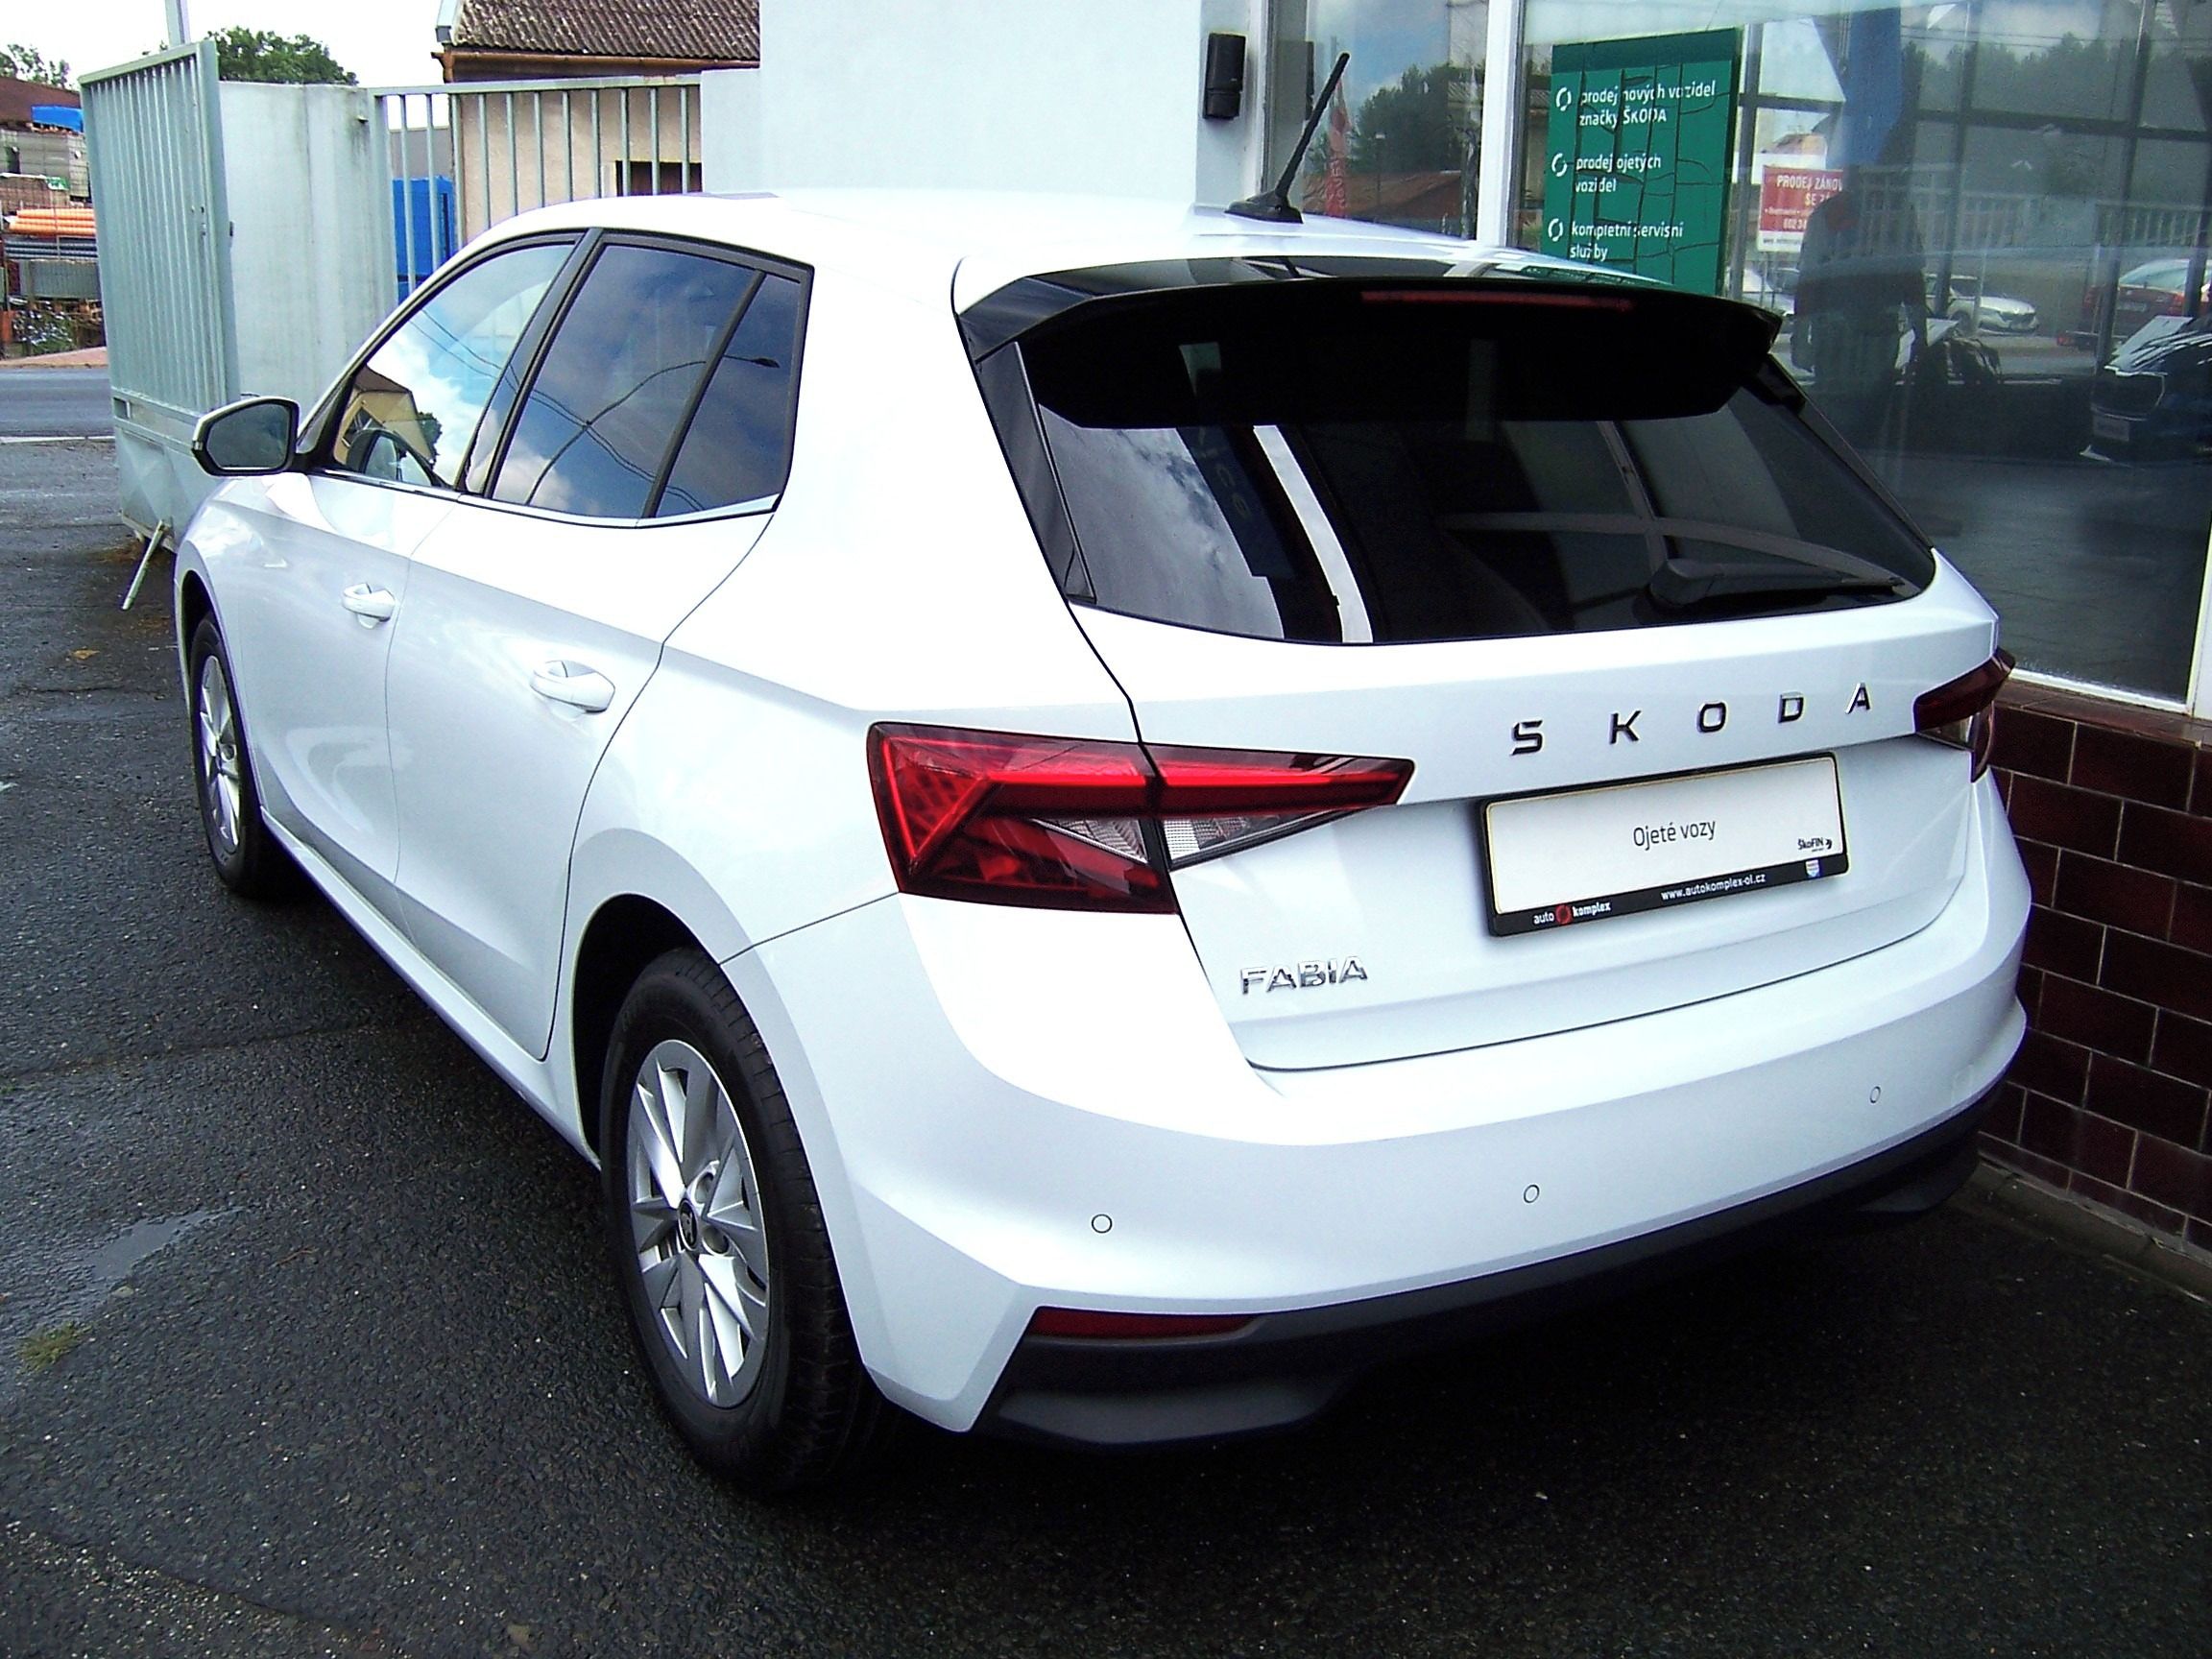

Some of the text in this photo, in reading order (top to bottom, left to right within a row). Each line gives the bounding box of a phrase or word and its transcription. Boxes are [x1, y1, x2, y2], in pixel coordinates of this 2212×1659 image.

[1580, 81, 1717, 106] prodej nových vozidel
[1579, 105, 1667, 129] značky ŠKODA
[1575, 154, 1662, 174] prodej ojetých
[1575, 177, 1617, 192] vozidel
[1776, 175, 1813, 190] PRODEJ
[1572, 221, 1684, 240] kompletní servisní
[1570, 243, 1608, 261] služby
[1633, 820, 1716, 851] Ojeté vozy
[1661, 872, 1767, 901] www.autokomplex-ol.cz
[1533, 901, 1611, 925] auto komplex
[1240, 956, 1368, 995] FABIA
